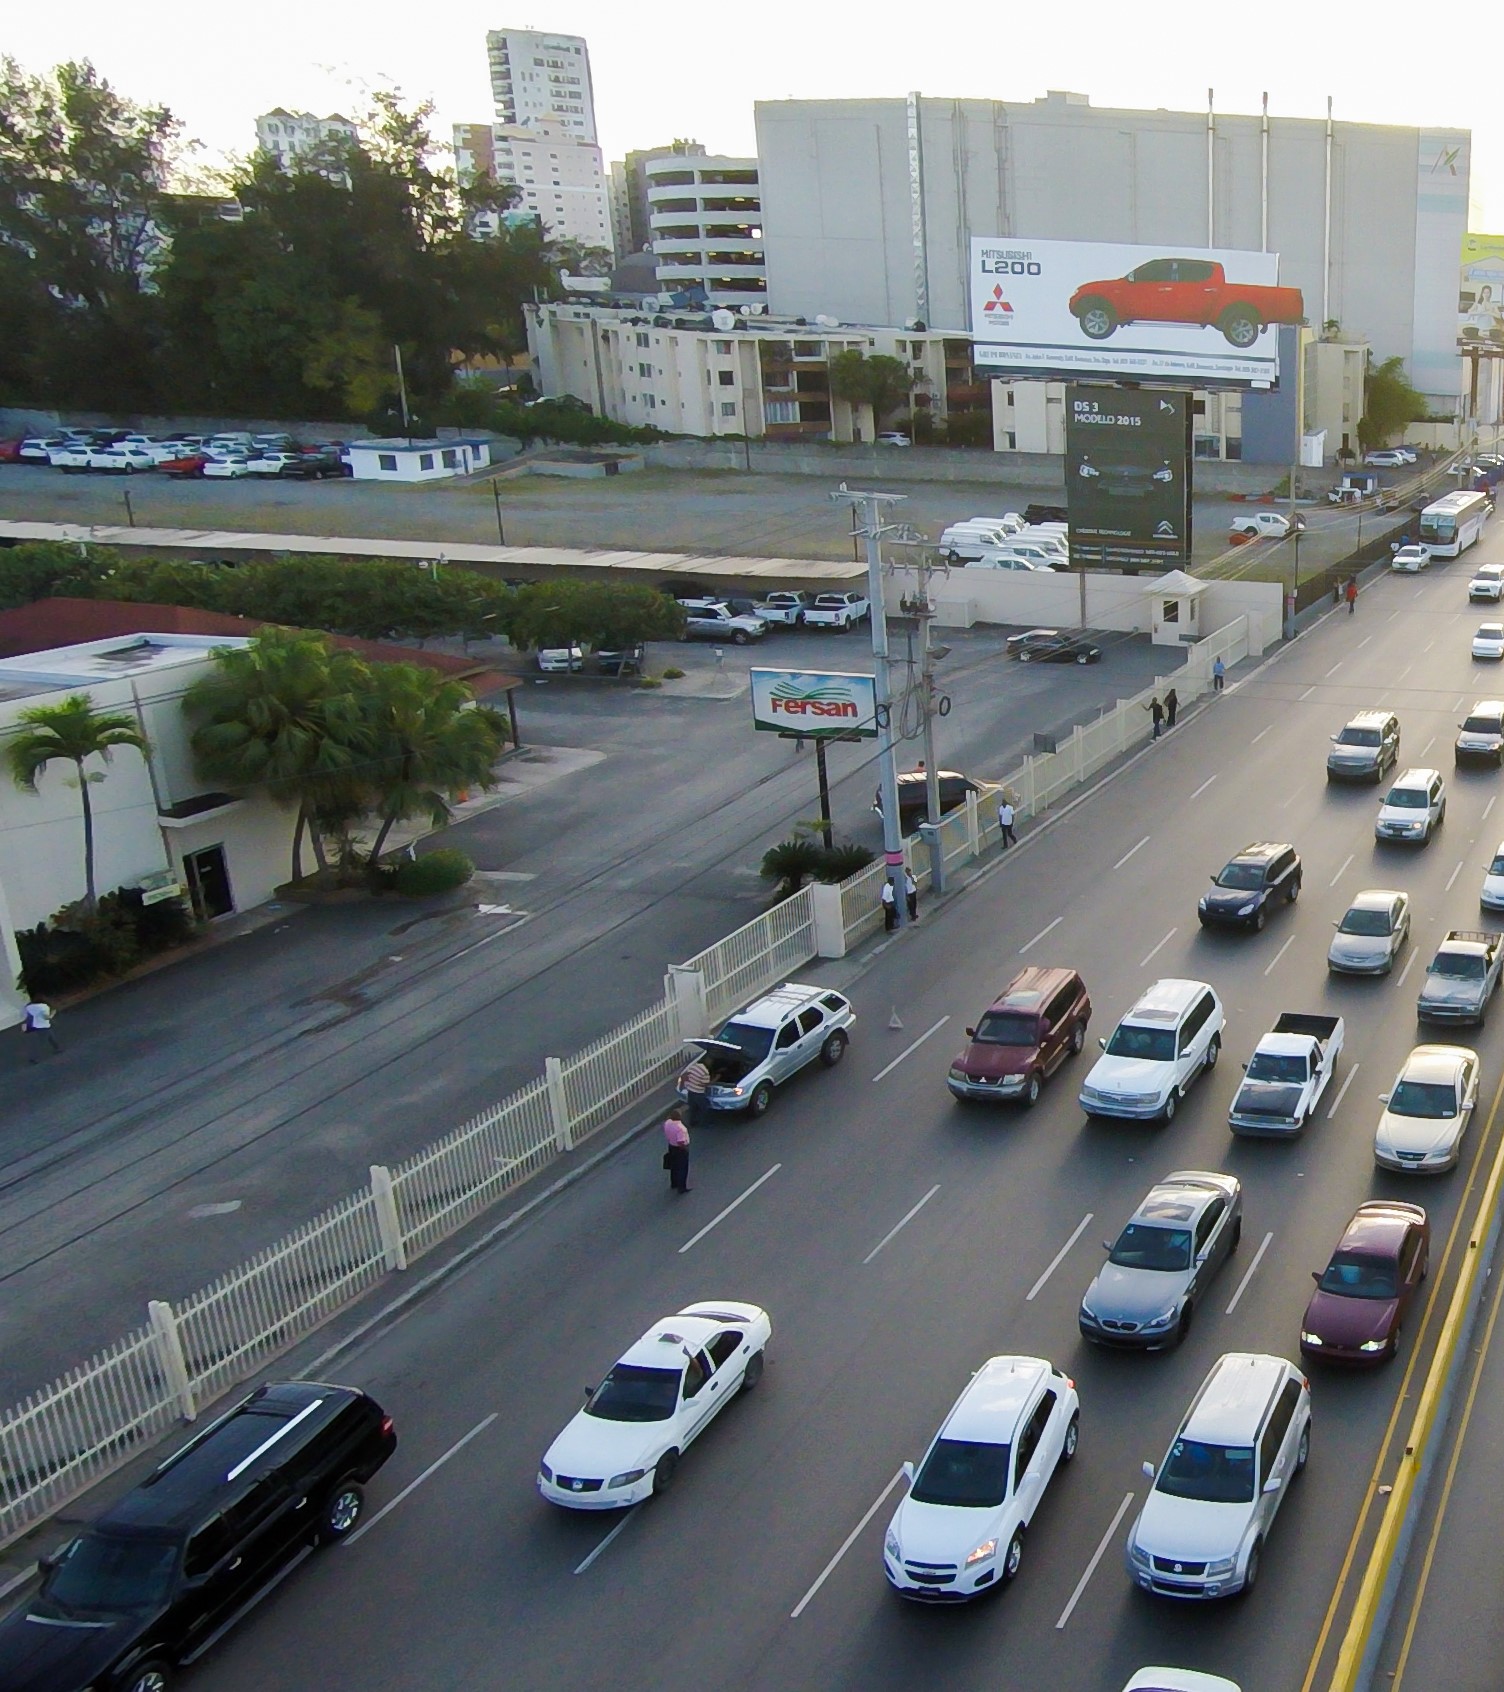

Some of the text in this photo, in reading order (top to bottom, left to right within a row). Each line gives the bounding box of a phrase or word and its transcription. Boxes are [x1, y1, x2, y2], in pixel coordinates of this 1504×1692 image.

[981, 249, 1032, 260] MITSUBISHI
[981, 260, 1041, 275] L200
[1074, 401, 1099, 412] DS 3
[1074, 413, 1141, 426] MODELO 2015
[771, 697, 858, 718] Fersan
